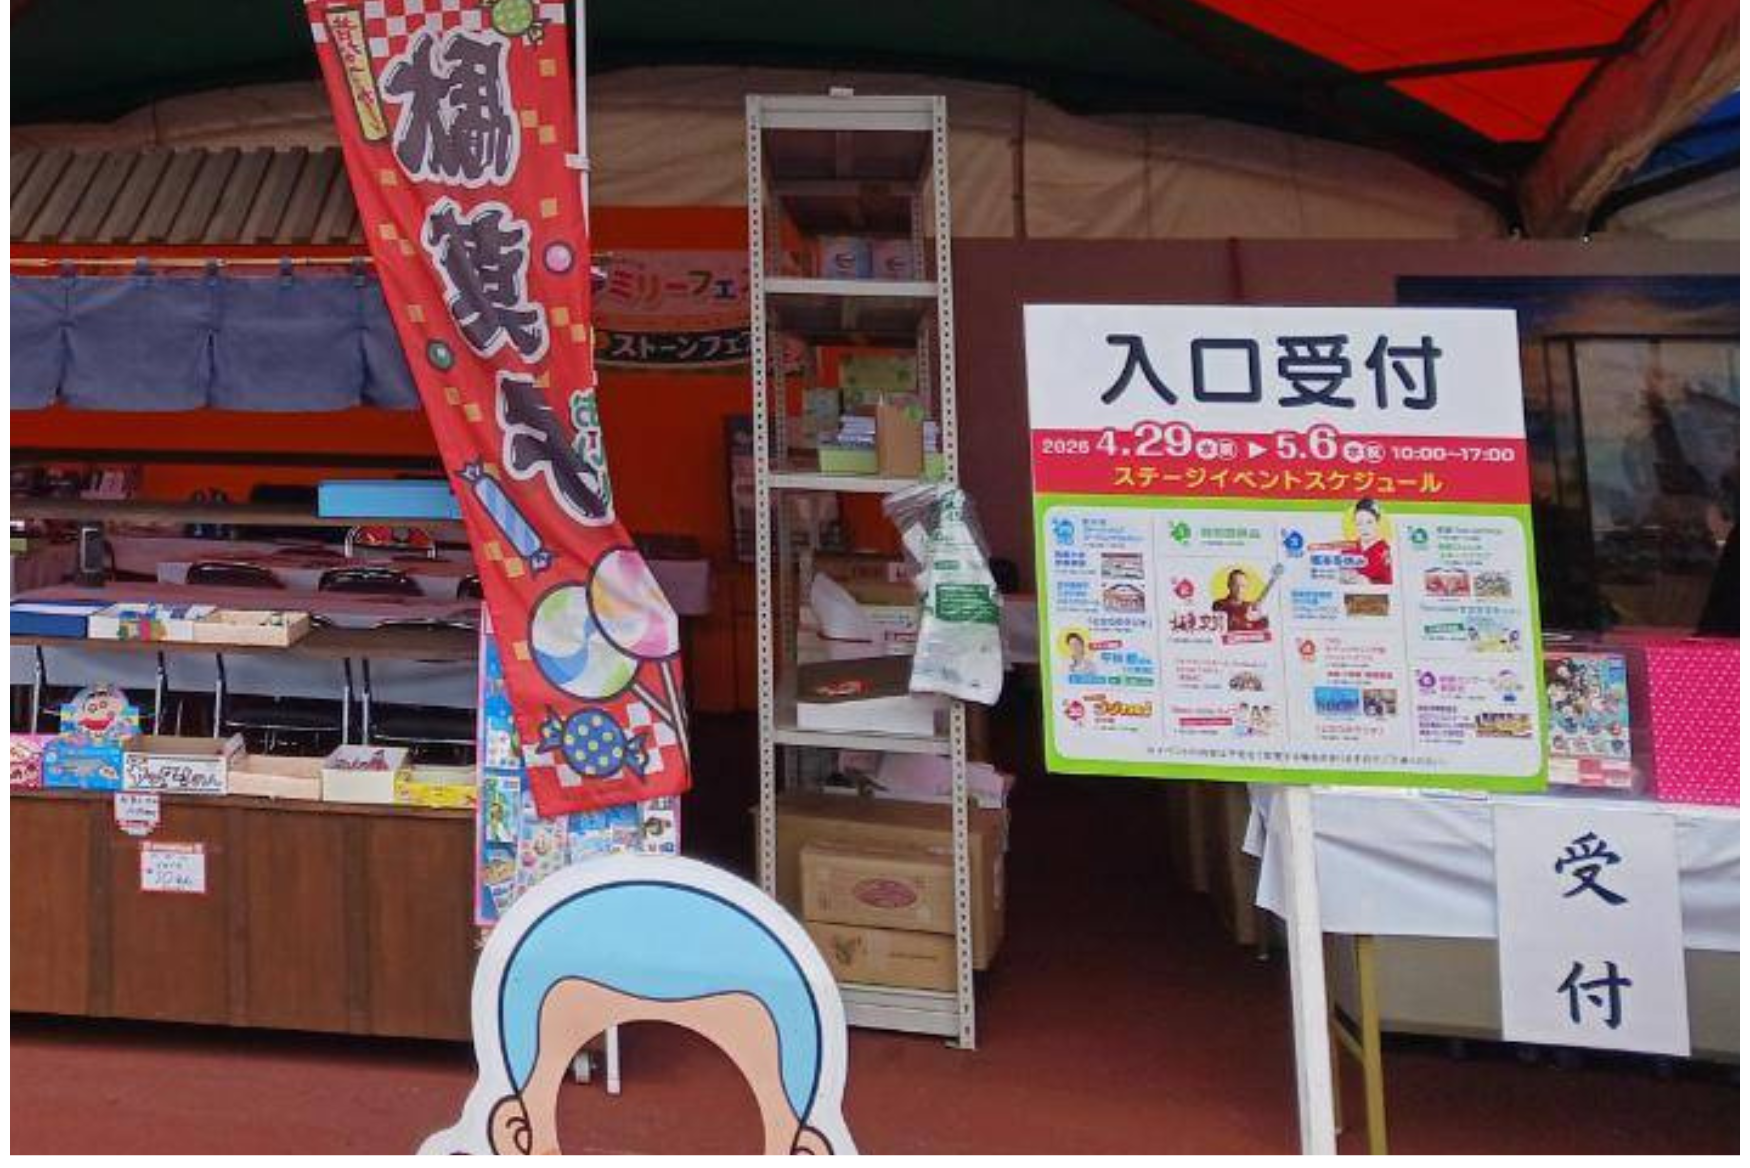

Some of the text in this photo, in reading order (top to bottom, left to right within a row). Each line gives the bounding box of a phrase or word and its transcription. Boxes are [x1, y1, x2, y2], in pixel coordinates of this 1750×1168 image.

[591, 268, 750, 304] ミリーフェ
[612, 332, 750, 359] ストーンフェ
[1101, 333, 1441, 409] 入口受付
[1096, 424, 1193, 457] 4.29
[1276, 427, 1338, 460] 5.6
[1113, 466, 1443, 494] ステージイベントスケジュール
[1554, 831, 1632, 1030] 受付
